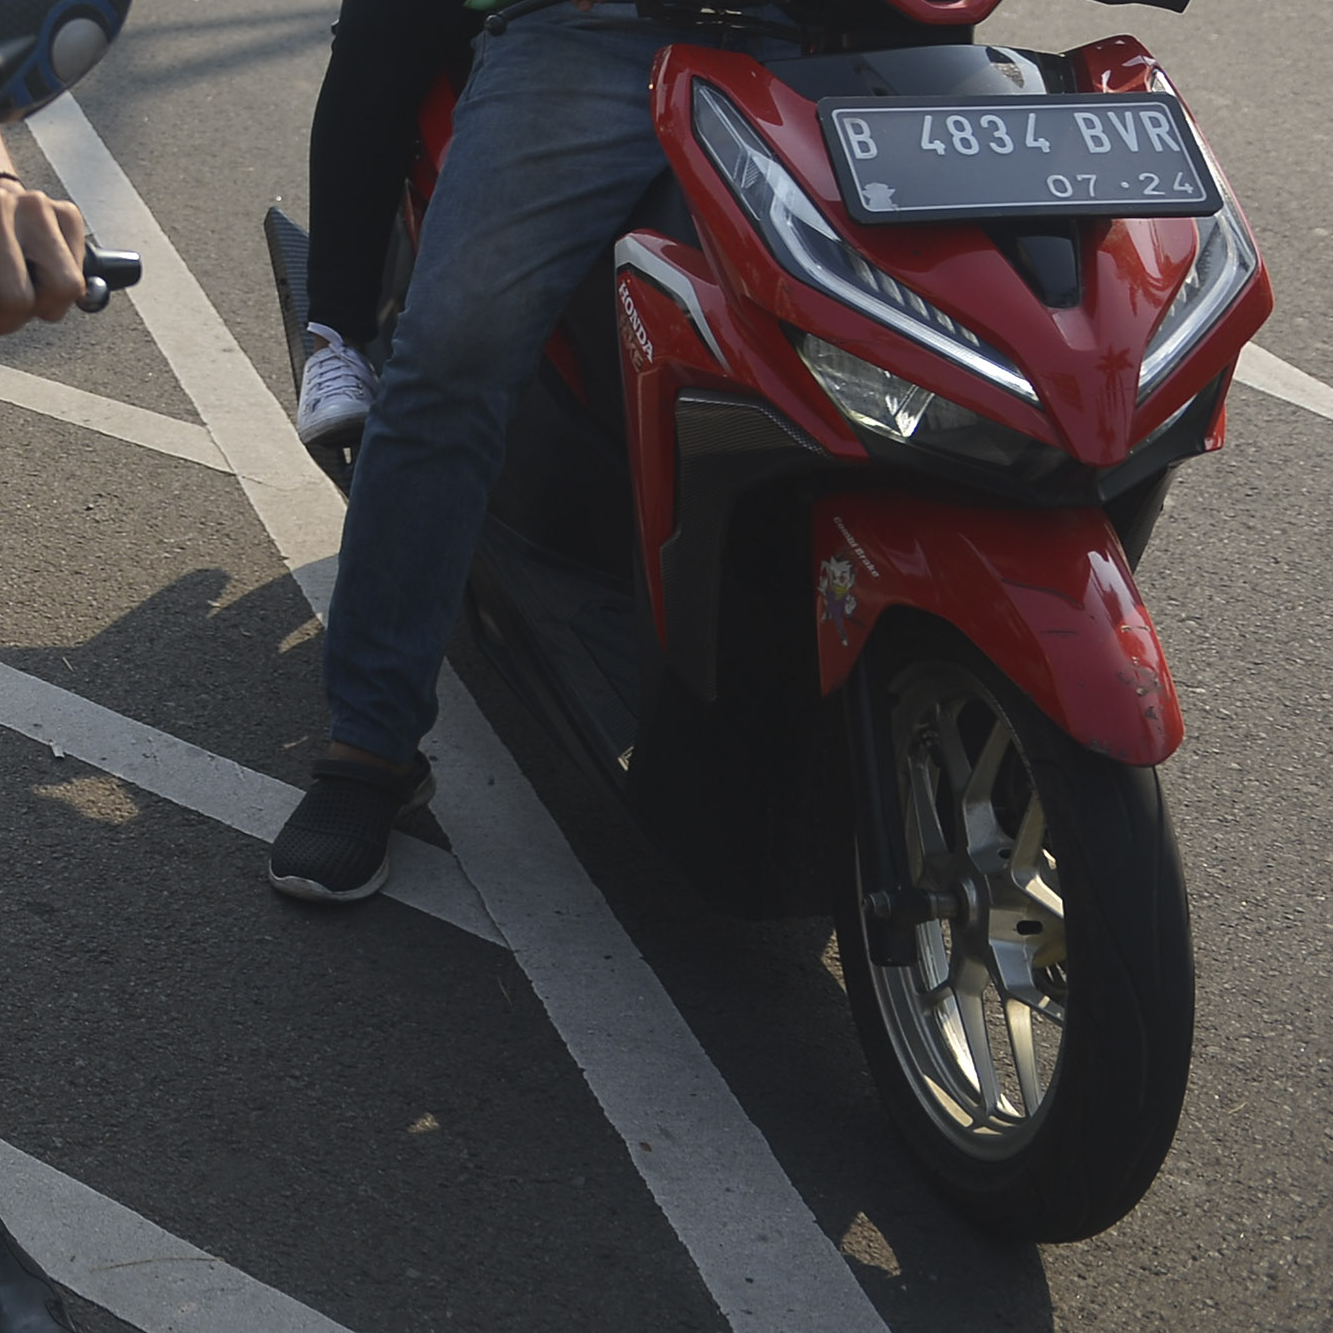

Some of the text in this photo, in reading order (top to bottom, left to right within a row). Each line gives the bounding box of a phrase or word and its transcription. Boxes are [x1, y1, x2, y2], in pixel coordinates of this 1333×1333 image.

[843, 110, 1181, 160] B 4834 BVR
[618, 279, 653, 363] HONDA
